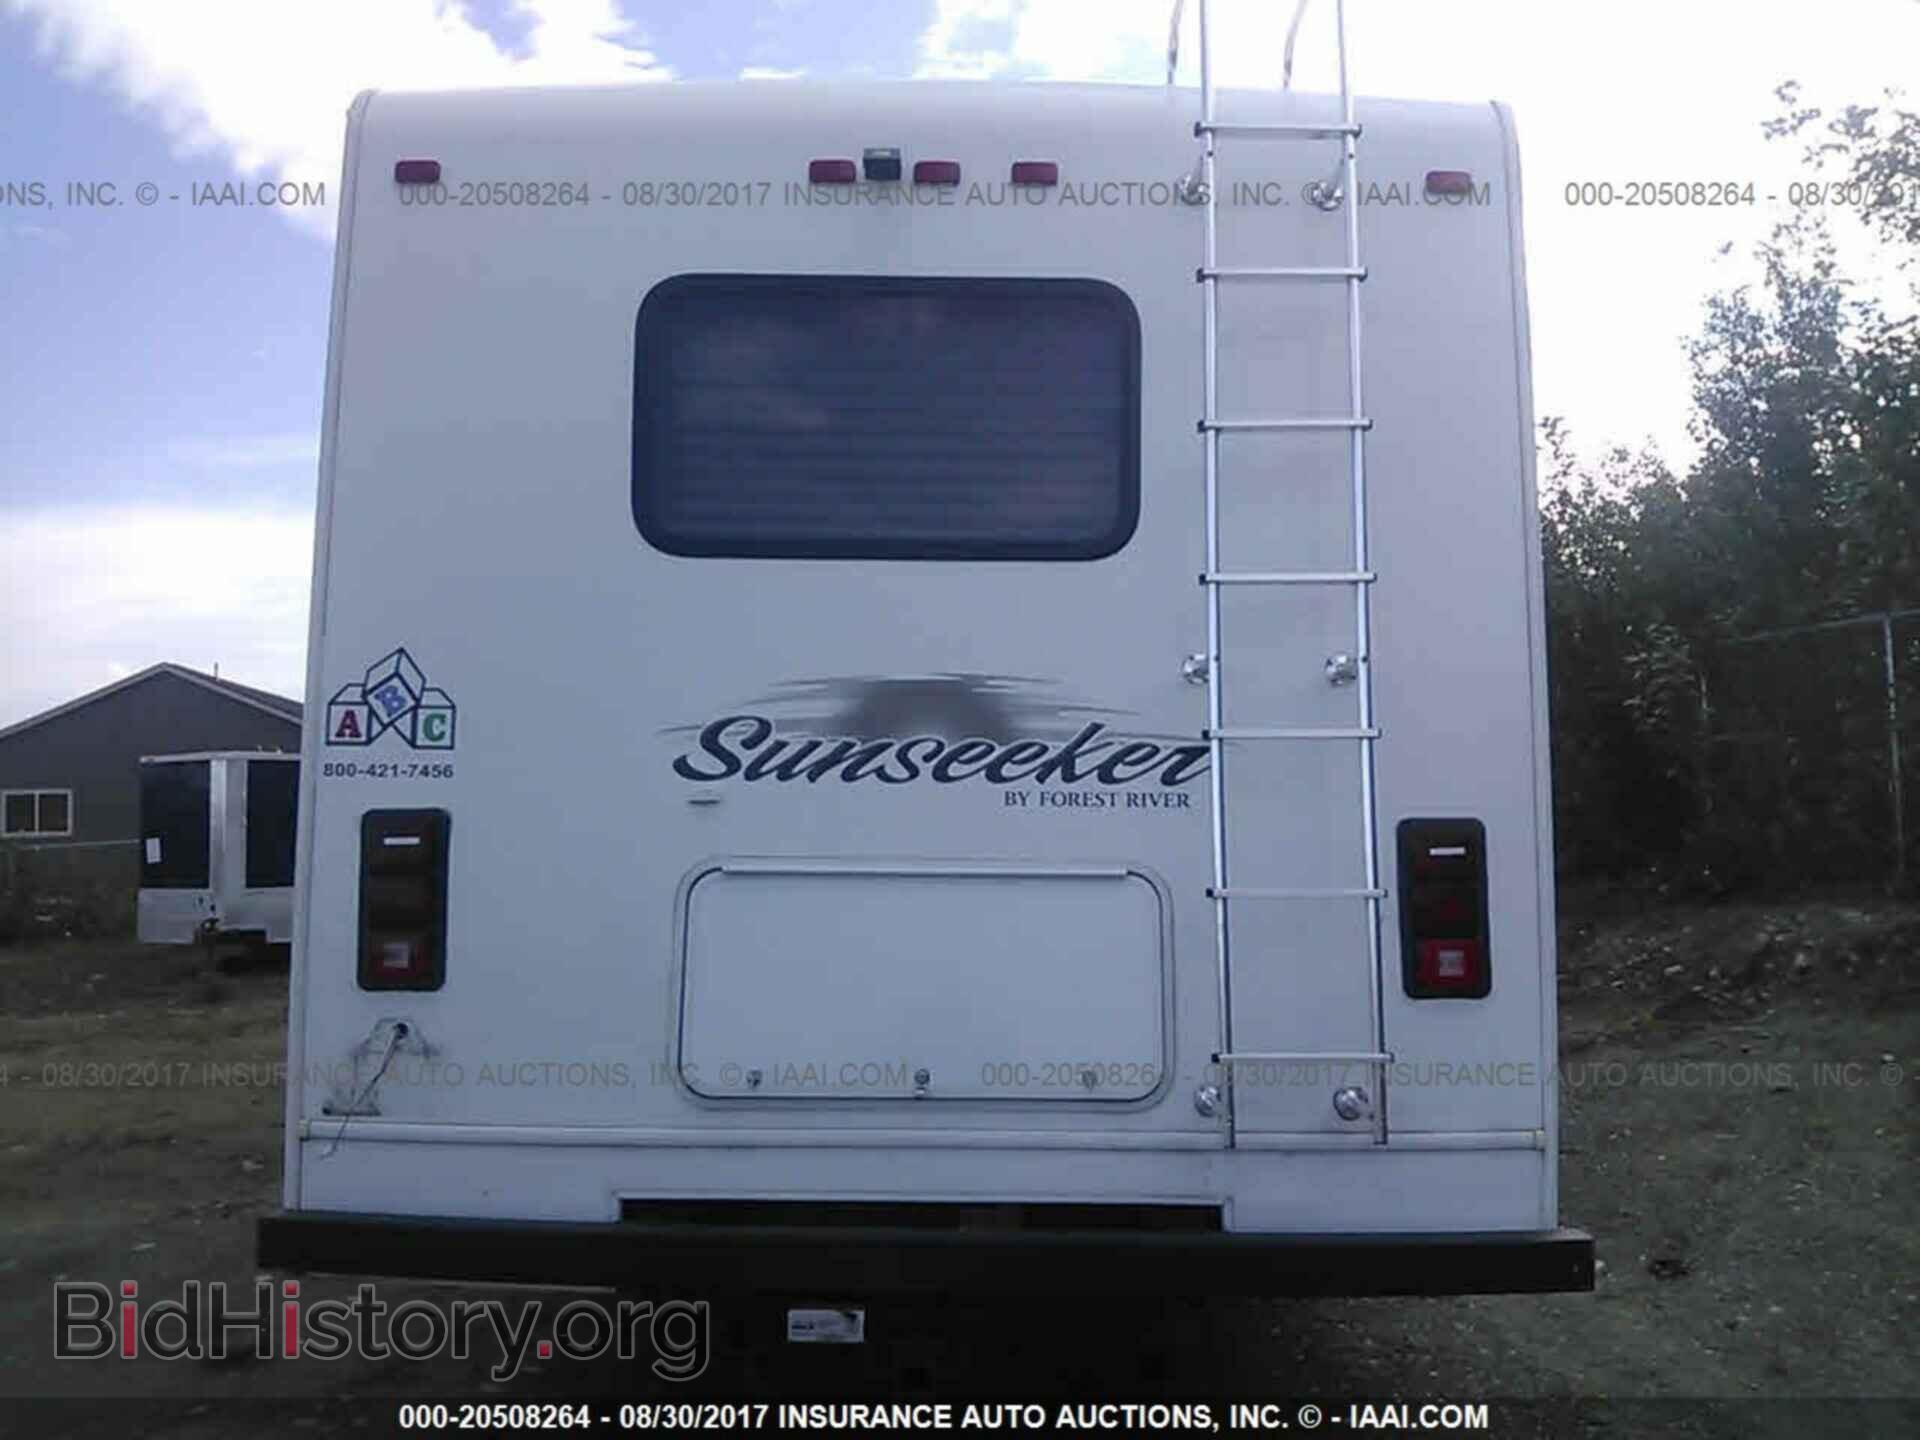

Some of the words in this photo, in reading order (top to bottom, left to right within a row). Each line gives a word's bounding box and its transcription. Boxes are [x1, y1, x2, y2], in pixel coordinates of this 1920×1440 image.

[672, 715, 1211, 786] Sunseeker
[323, 763, 454, 778] 800-421-7456
[1004, 791, 1030, 807] BY
[1040, 791, 1117, 808] FOREST
[1127, 792, 1190, 808] RIVER
